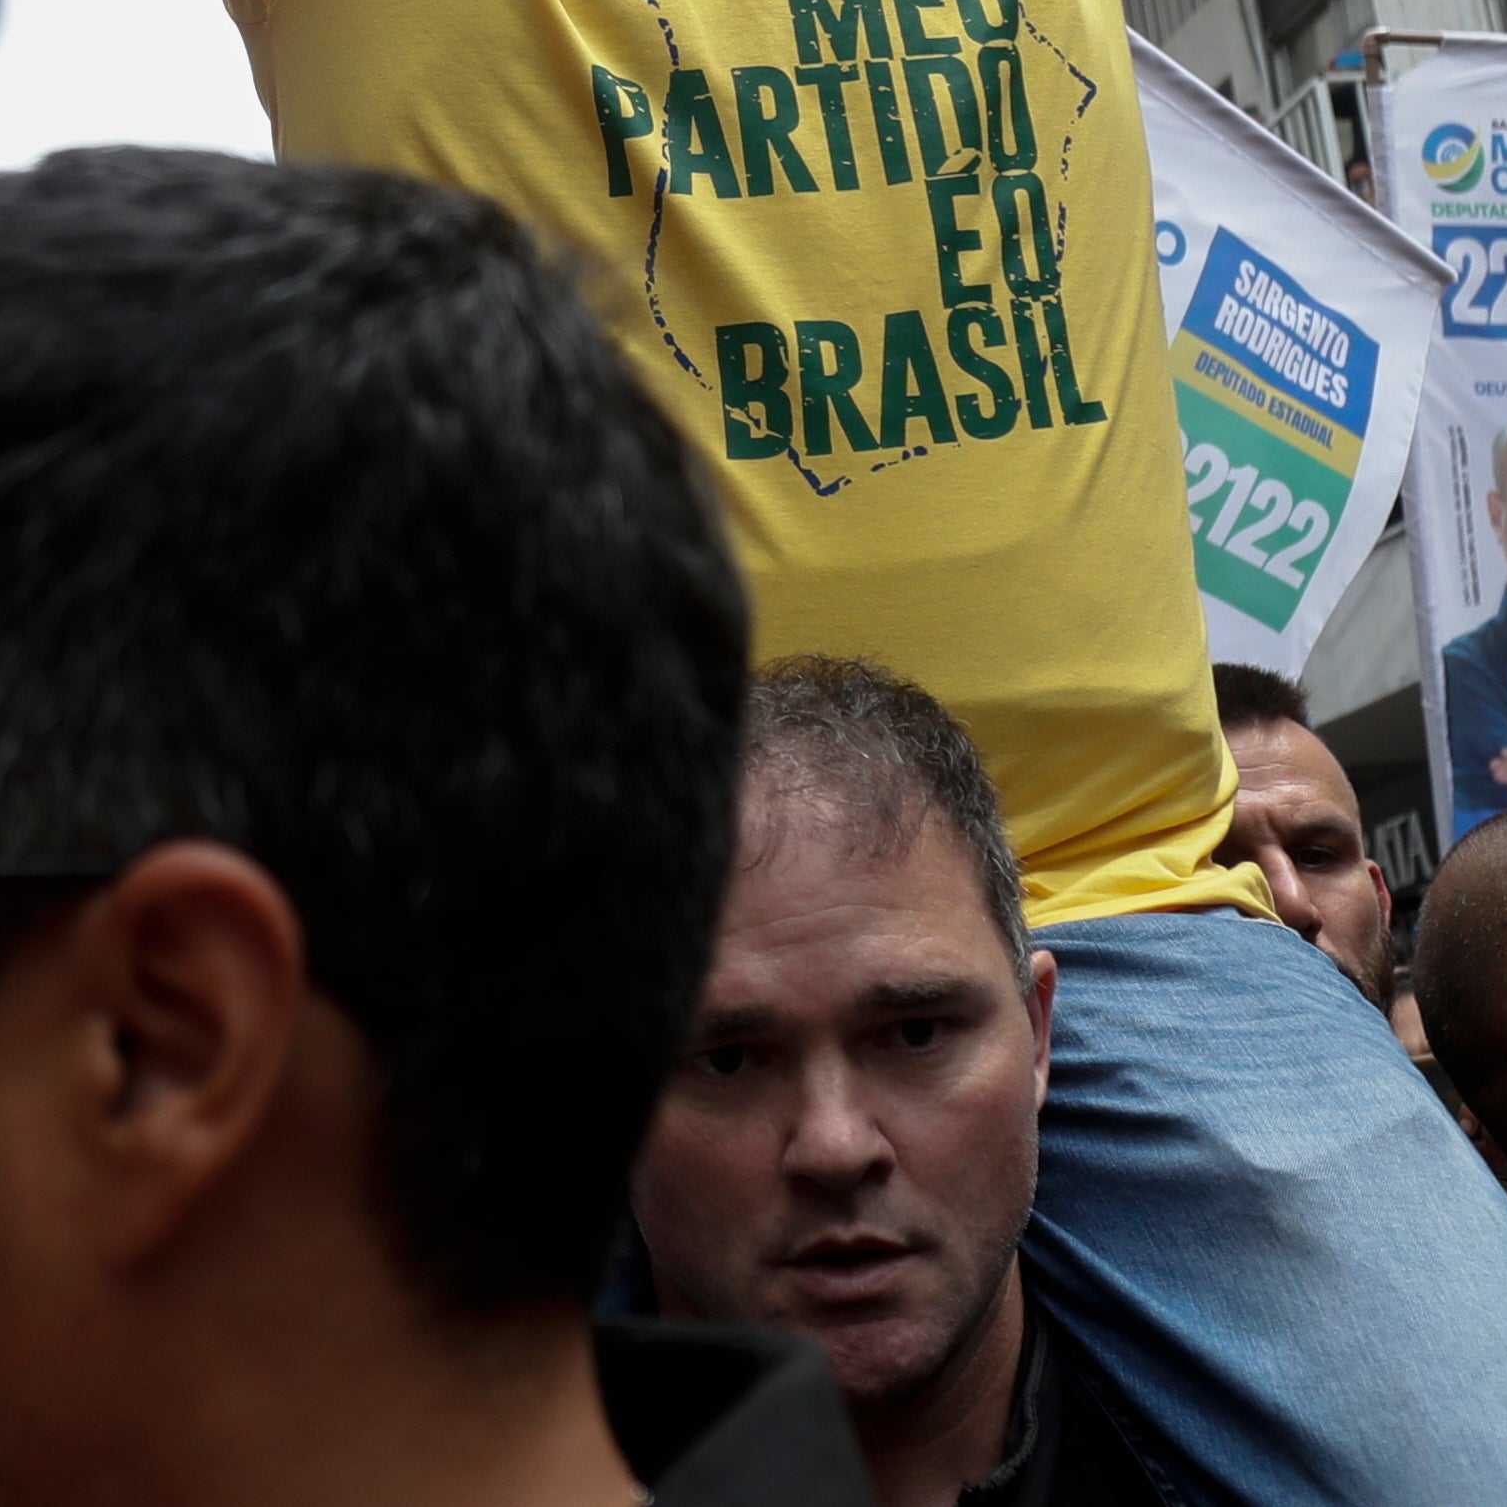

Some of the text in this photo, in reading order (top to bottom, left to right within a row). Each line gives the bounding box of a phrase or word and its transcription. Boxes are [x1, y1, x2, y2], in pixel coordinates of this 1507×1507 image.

[591, 43, 1039, 198] PARTIDO
[715, 294, 1108, 461] BRASIL
[1214, 294, 1348, 408] RODRIGUES
[1235, 260, 1349, 368] SARGENTO
[1195, 351, 1333, 449] DEPUTADO ESTADUAL
[1180, 428, 1330, 590] 2122
